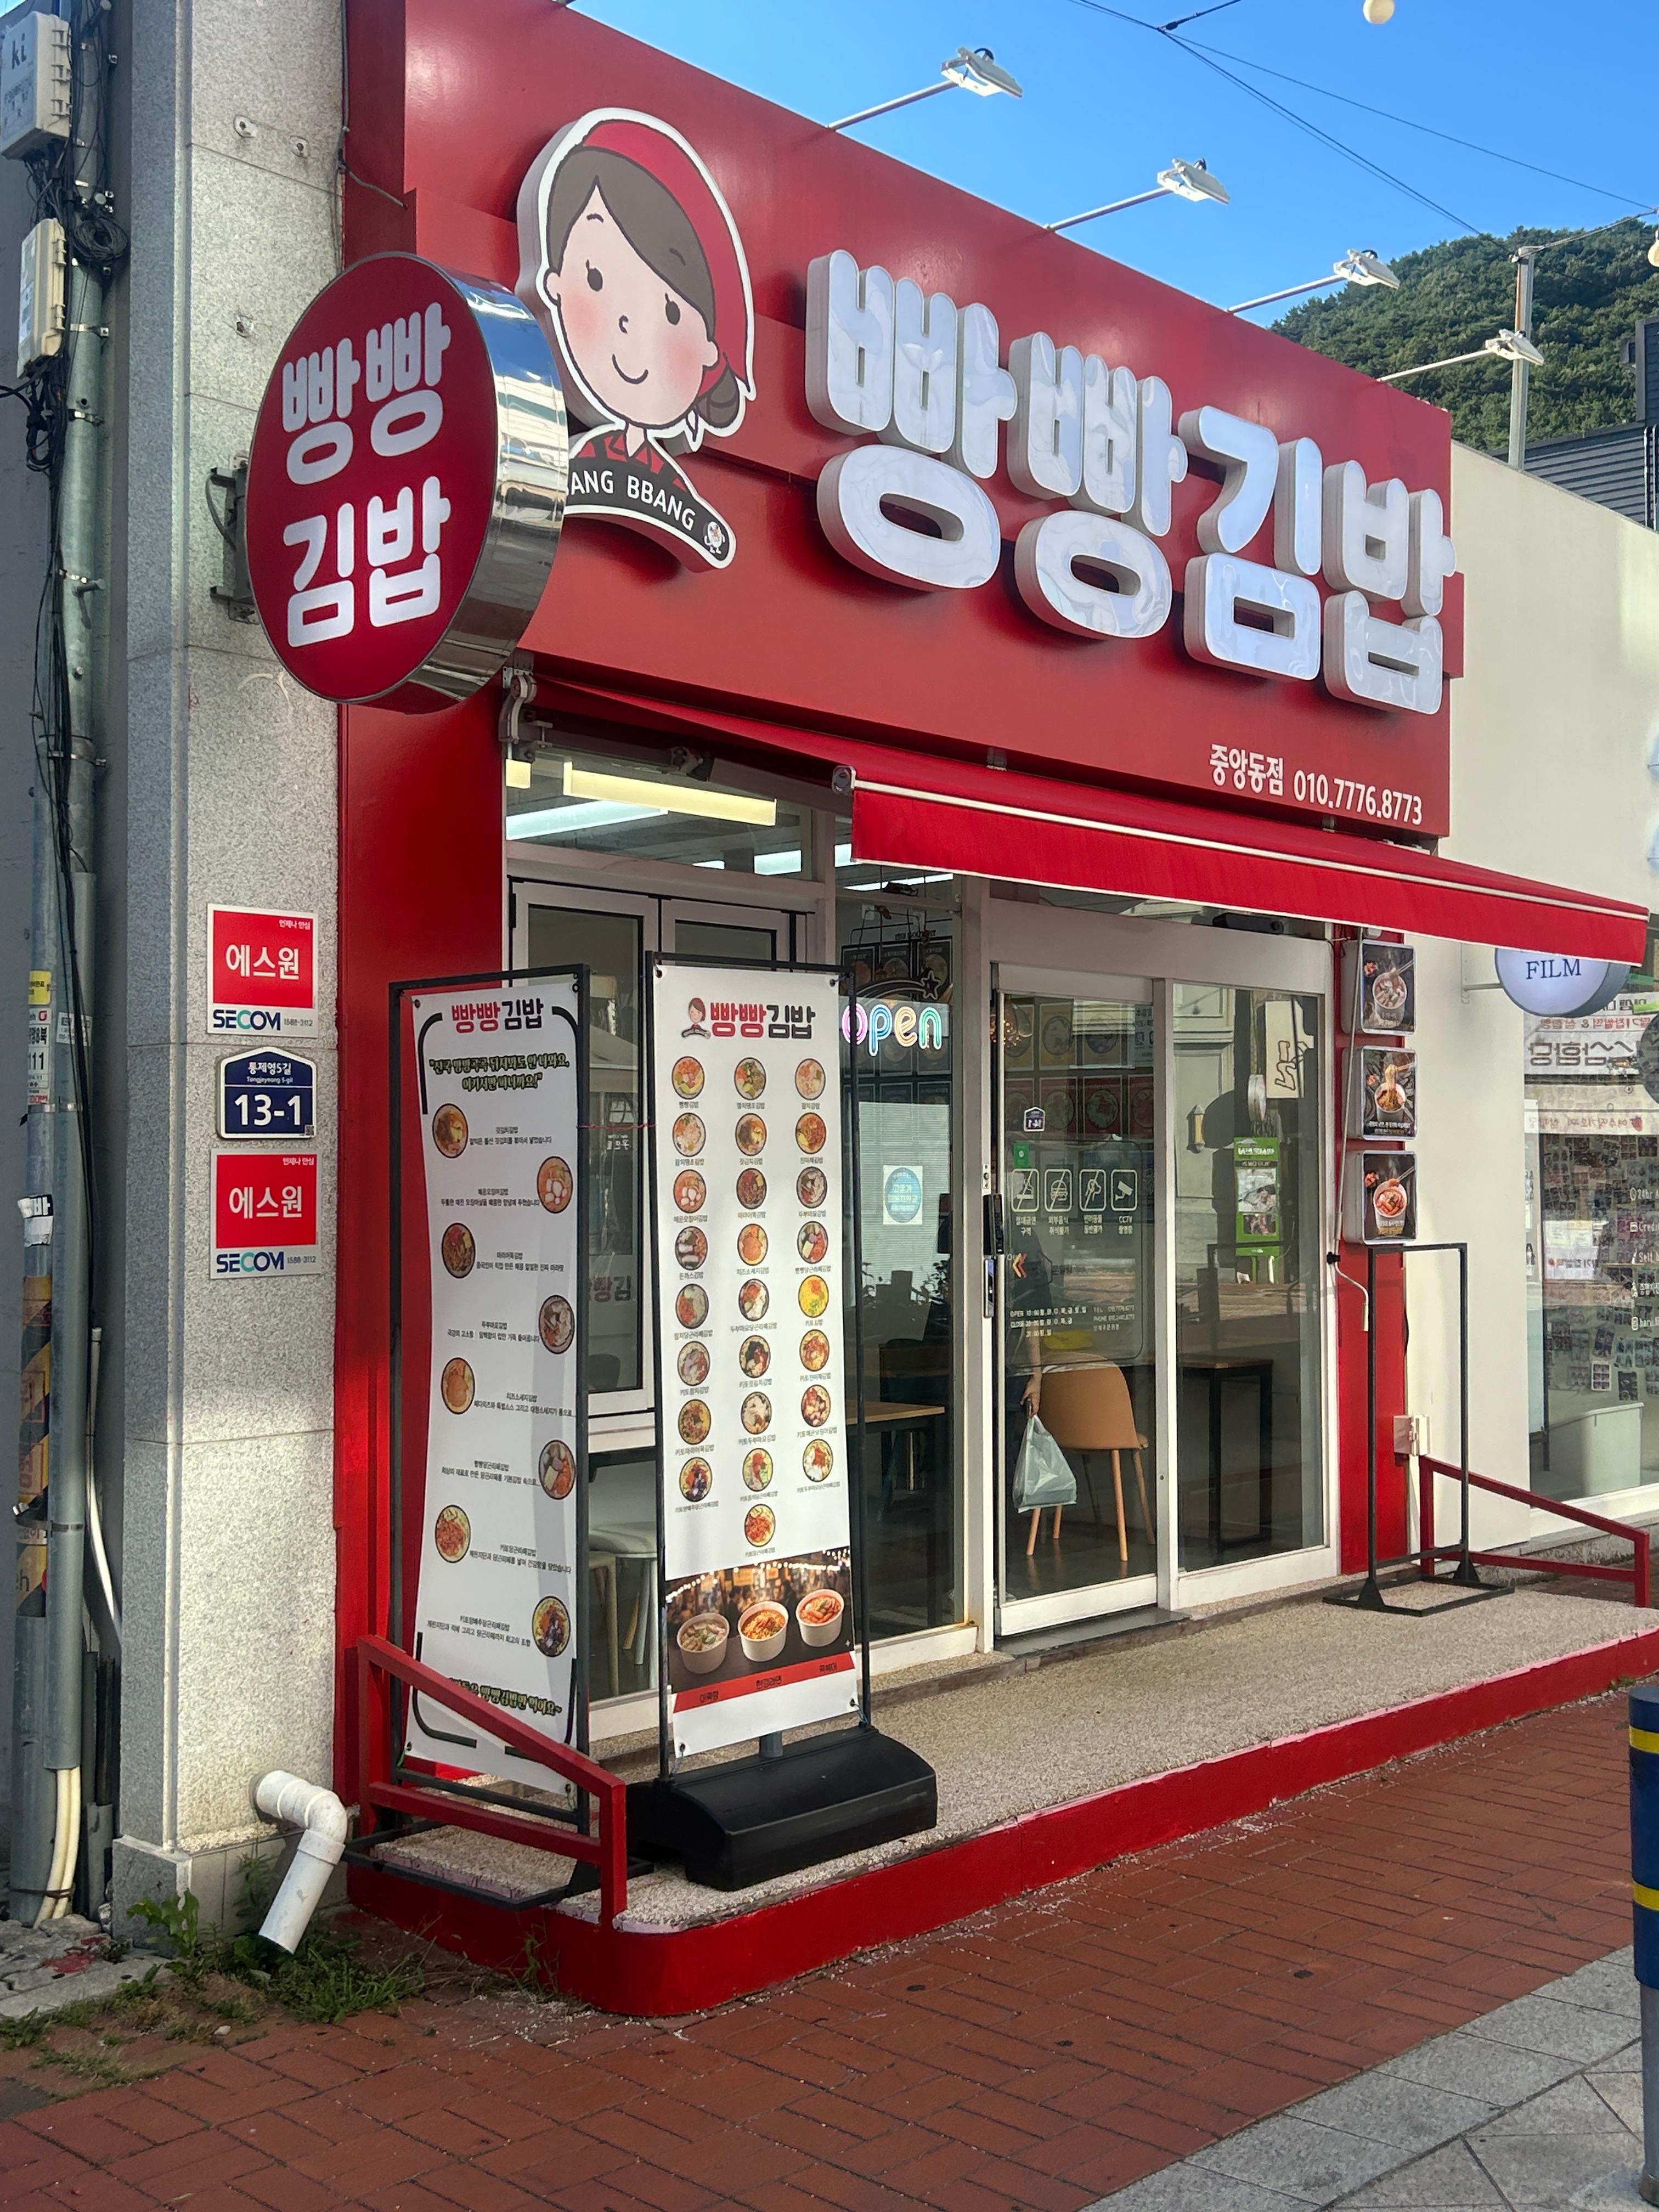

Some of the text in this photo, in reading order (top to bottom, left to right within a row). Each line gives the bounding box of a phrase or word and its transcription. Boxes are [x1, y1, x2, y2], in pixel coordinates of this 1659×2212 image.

[283, 302, 451, 485] 빵빵
[805, 249, 1457, 715] 빵빵김밥
[567, 470, 696, 531] ANG BBANG
[283, 476, 451, 647] 김밥
[1209, 743, 1423, 826] 중앙동점 010.7776.8773
[225, 944, 299, 980] 에스원
[1526, 958, 1582, 979] FILM
[213, 1009, 281, 1031] SECOM
[452, 998, 544, 1034] 빵빵김밥
[710, 1002, 816, 1039] 빵빵김밥
[248, 1062, 291, 1075] 통제영5길
[234, 1094, 301, 1126] 13-1
[229, 1186, 302, 1219] 에스원
[1118, 1215, 1132, 1224] CCTV
[216, 1251, 284, 1273] SECOM
